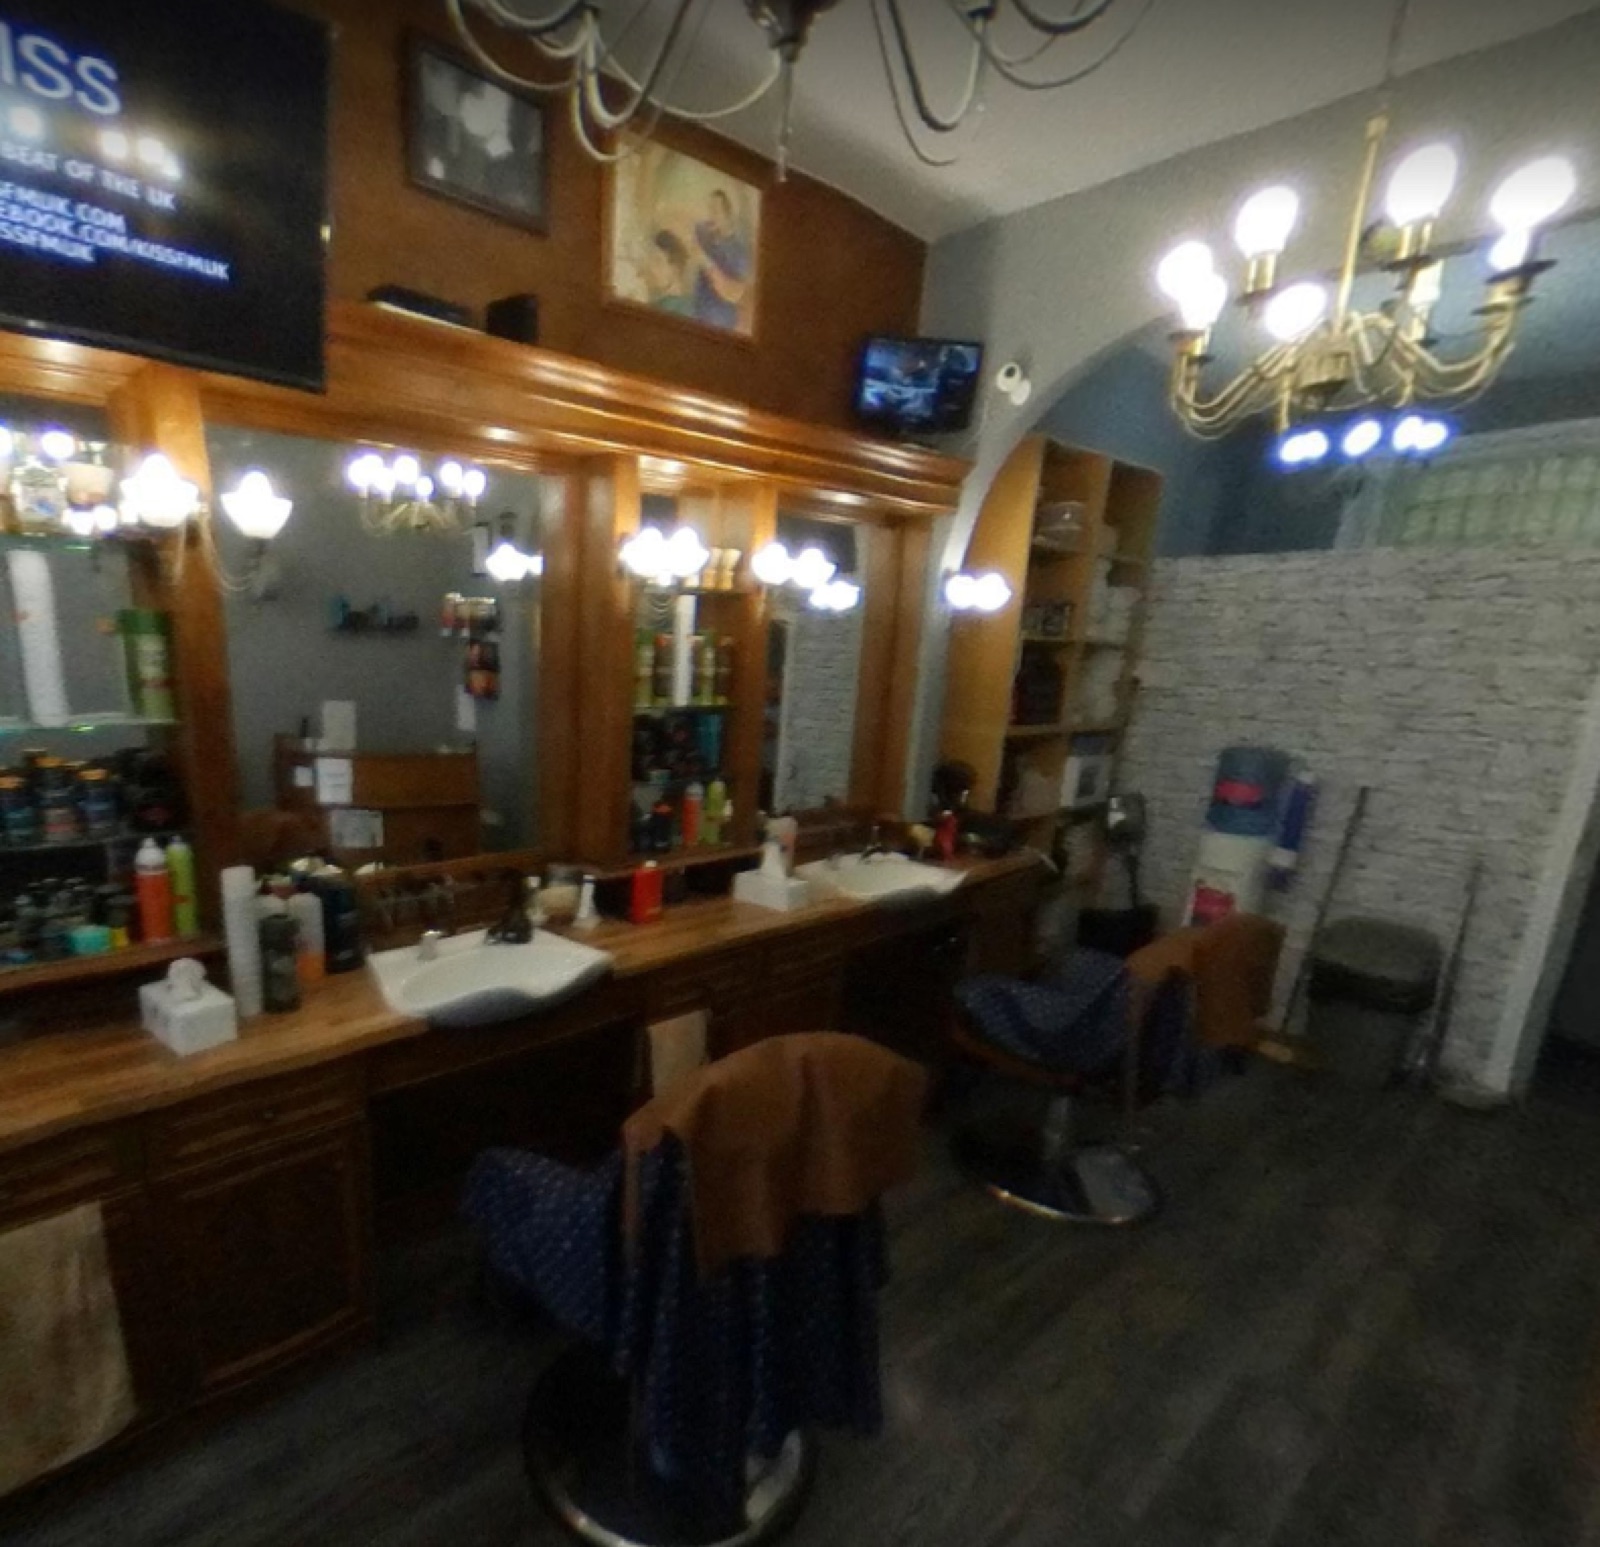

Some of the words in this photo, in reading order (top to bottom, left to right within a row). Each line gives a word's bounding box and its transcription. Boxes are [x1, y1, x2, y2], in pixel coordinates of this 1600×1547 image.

[64, 159, 95, 182] OF
[101, 169, 139, 199] THE
[146, 185, 176, 210] UK
